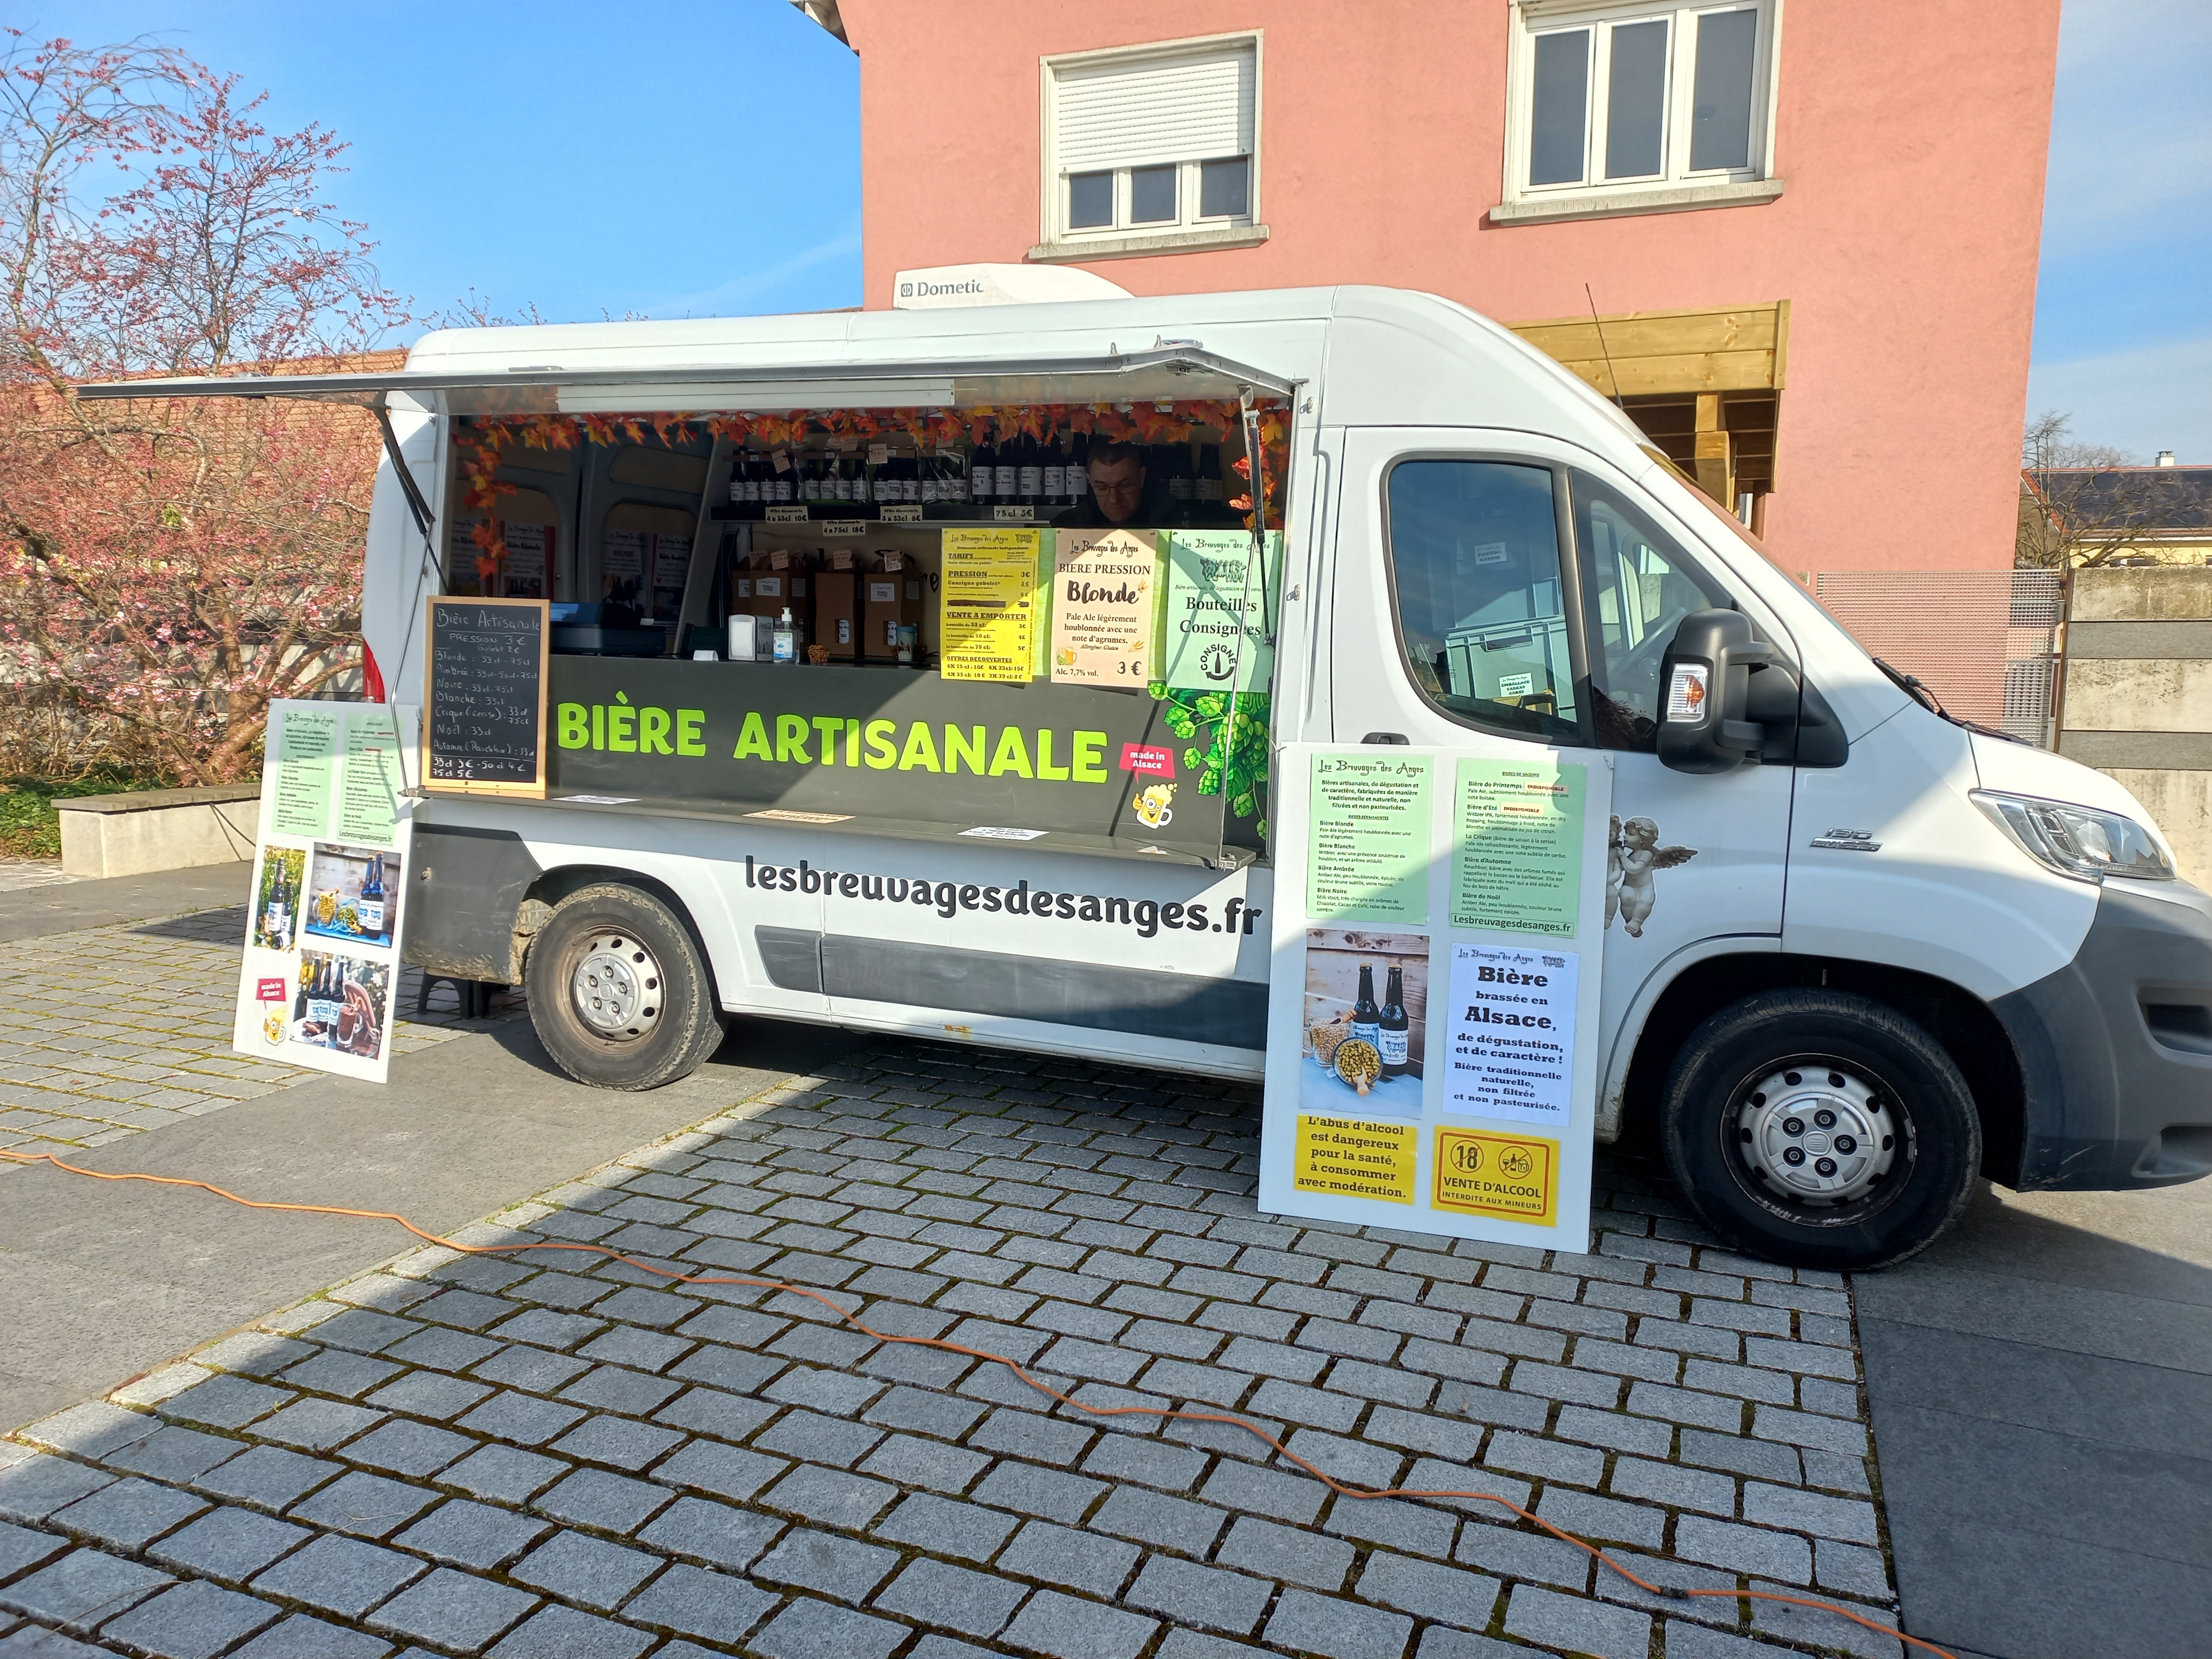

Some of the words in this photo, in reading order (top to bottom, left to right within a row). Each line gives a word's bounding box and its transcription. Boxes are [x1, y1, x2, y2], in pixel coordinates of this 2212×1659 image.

[917, 280, 984, 297] Dometic
[1070, 540, 1079, 554] Les
[1081, 540, 1108, 557] Breuvages
[1107, 541, 1117, 552] des
[1120, 541, 1138, 557] Anges
[1180, 538, 1192, 550] Les
[1195, 539, 1230, 553] Breuvages
[1229, 539, 1243, 548] des
[1059, 564, 1092, 573] BIERE
[1094, 564, 1150, 575] PRESSION
[1067, 580, 1139, 604] Blonde
[437, 608, 469, 627] Bière
[478, 609, 540, 630] Artisanale
[1097, 614, 1137, 623] légèrement
[1064, 624, 1105, 632] houblonnée
[449, 633, 497, 643] PRESSION
[504, 635, 512, 644] 3
[516, 637, 526, 645] €
[1089, 636, 1128, 644] d'agrumes.
[435, 650, 466, 661] Blonde
[1200, 644, 1236, 671] CONSIGNE
[1117, 661, 1126, 674] 3
[1131, 661, 1142, 675] €
[436, 691, 475, 704] Blanche
[437, 724, 459, 735] Noël
[557, 690, 706, 757] BIÈRE
[733, 712, 1108, 784] ARTISANALE
[1130, 751, 1154, 759] made
[1156, 752, 1165, 760] in
[1132, 760, 1162, 769] Alsace
[1318, 760, 1332, 773] Les
[1336, 760, 1377, 776] Breuvages
[1376, 761, 1392, 772] des
[1396, 762, 1424, 777] Anges
[339, 830, 392, 842] Lesbreuvagesdesanges.fr
[1825, 828, 1873, 840] 130
[745, 855, 1262, 938] lesbreuvagesdesanges.fr
[1454, 915, 1571, 932] Lesbreuvagesdesanges.fr
[1459, 949, 1468, 957] Les
[1513, 953, 1533, 964] Anges
[1478, 966, 1548, 987] Bière
[1476, 991, 1528, 1003] brassée
[1465, 1006, 1556, 1031] Alsace,
[1458, 1033, 1473, 1042] de
[1477, 1035, 1563, 1052] dégustation,
[1471, 1047, 1487, 1056] de
[1490, 1051, 1555, 1063] caractère
[1455, 1062, 1482, 1071] Bière
[1487, 1066, 1562, 1080] traditionnelle
[1482, 1077, 1534, 1088] naturelle,
[1503, 1088, 1536, 1097] filtrée
[1493, 1098, 1560, 1111] pasteurisée.
[1307, 1116, 1349, 1128] L'abus
[1353, 1121, 1404, 1135] d'alcool
[1311, 1133, 1328, 1142] est
[1332, 1134, 1399, 1150] dangereux
[1311, 1149, 1340, 1158] pour
[1343, 1150, 1355, 1161] la
[1359, 1154, 1396, 1167] santé,
[1457, 1146, 1478, 1169] 18
[1310, 1162, 1317, 1171] à
[1321, 1165, 1396, 1181] consommer
[1298, 1178, 1326, 1187] avec
[1329, 1181, 1406, 1198] modération.
[1444, 1176, 1481, 1190] VENTE
[1483, 1182, 1541, 1198] D'ALCOOL
[1442, 1191, 1483, 1202] INTERDITE
[1505, 1199, 1541, 1210] MINEURS
